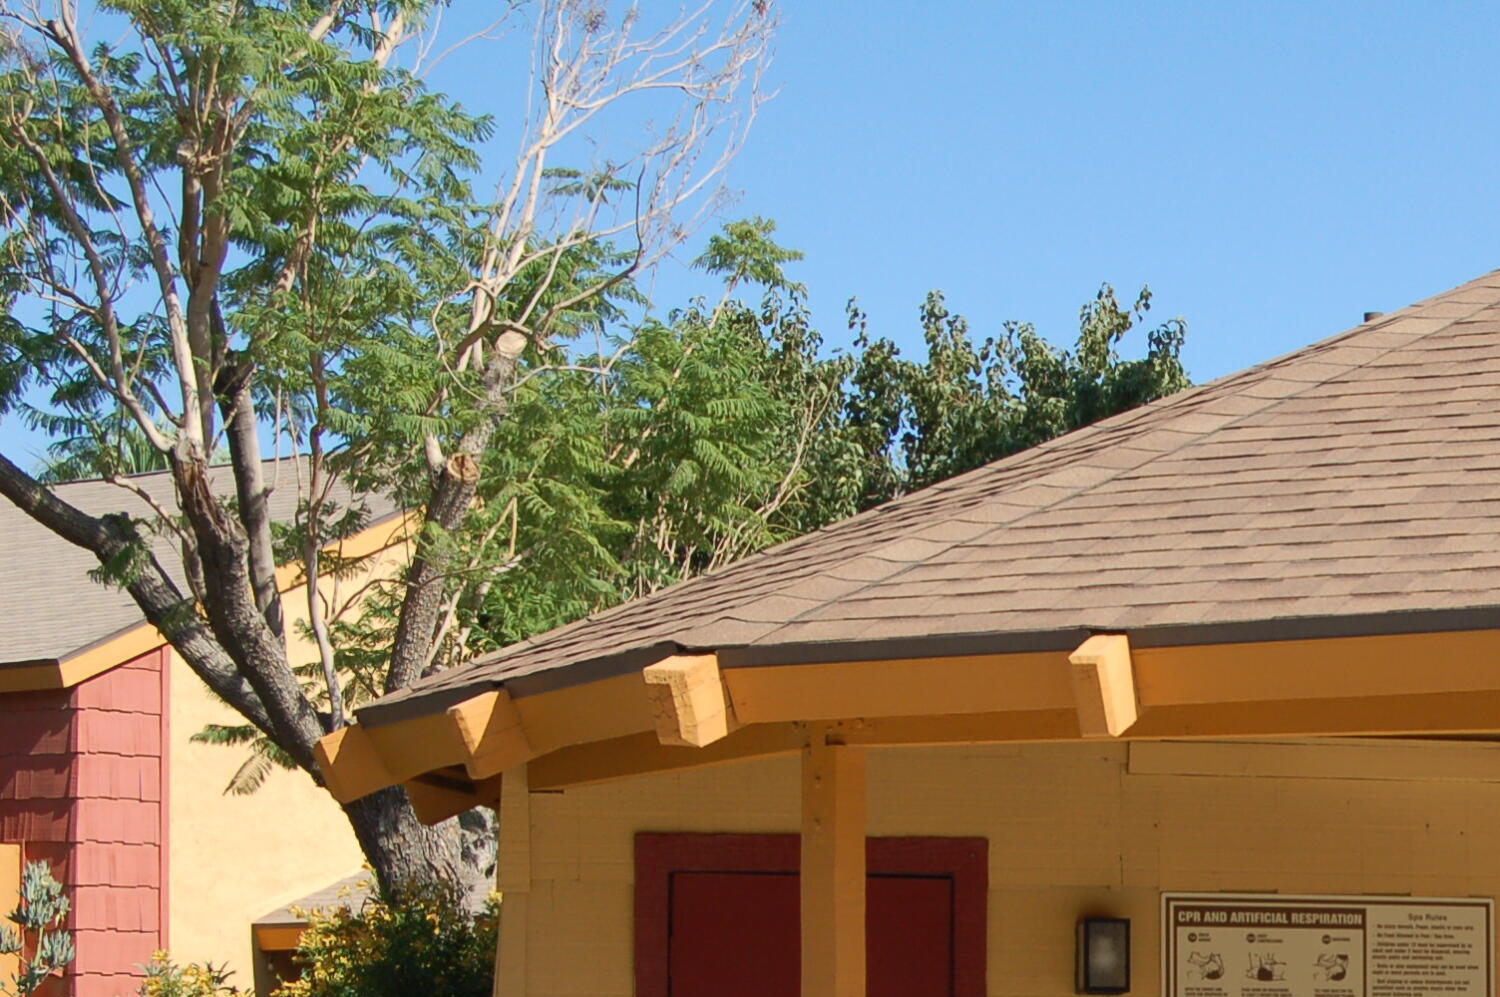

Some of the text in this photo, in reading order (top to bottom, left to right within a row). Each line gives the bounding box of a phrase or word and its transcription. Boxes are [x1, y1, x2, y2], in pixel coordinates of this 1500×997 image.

[1178, 910, 1362, 925] CPR AND ARTIFICIAL RESPIRATION
